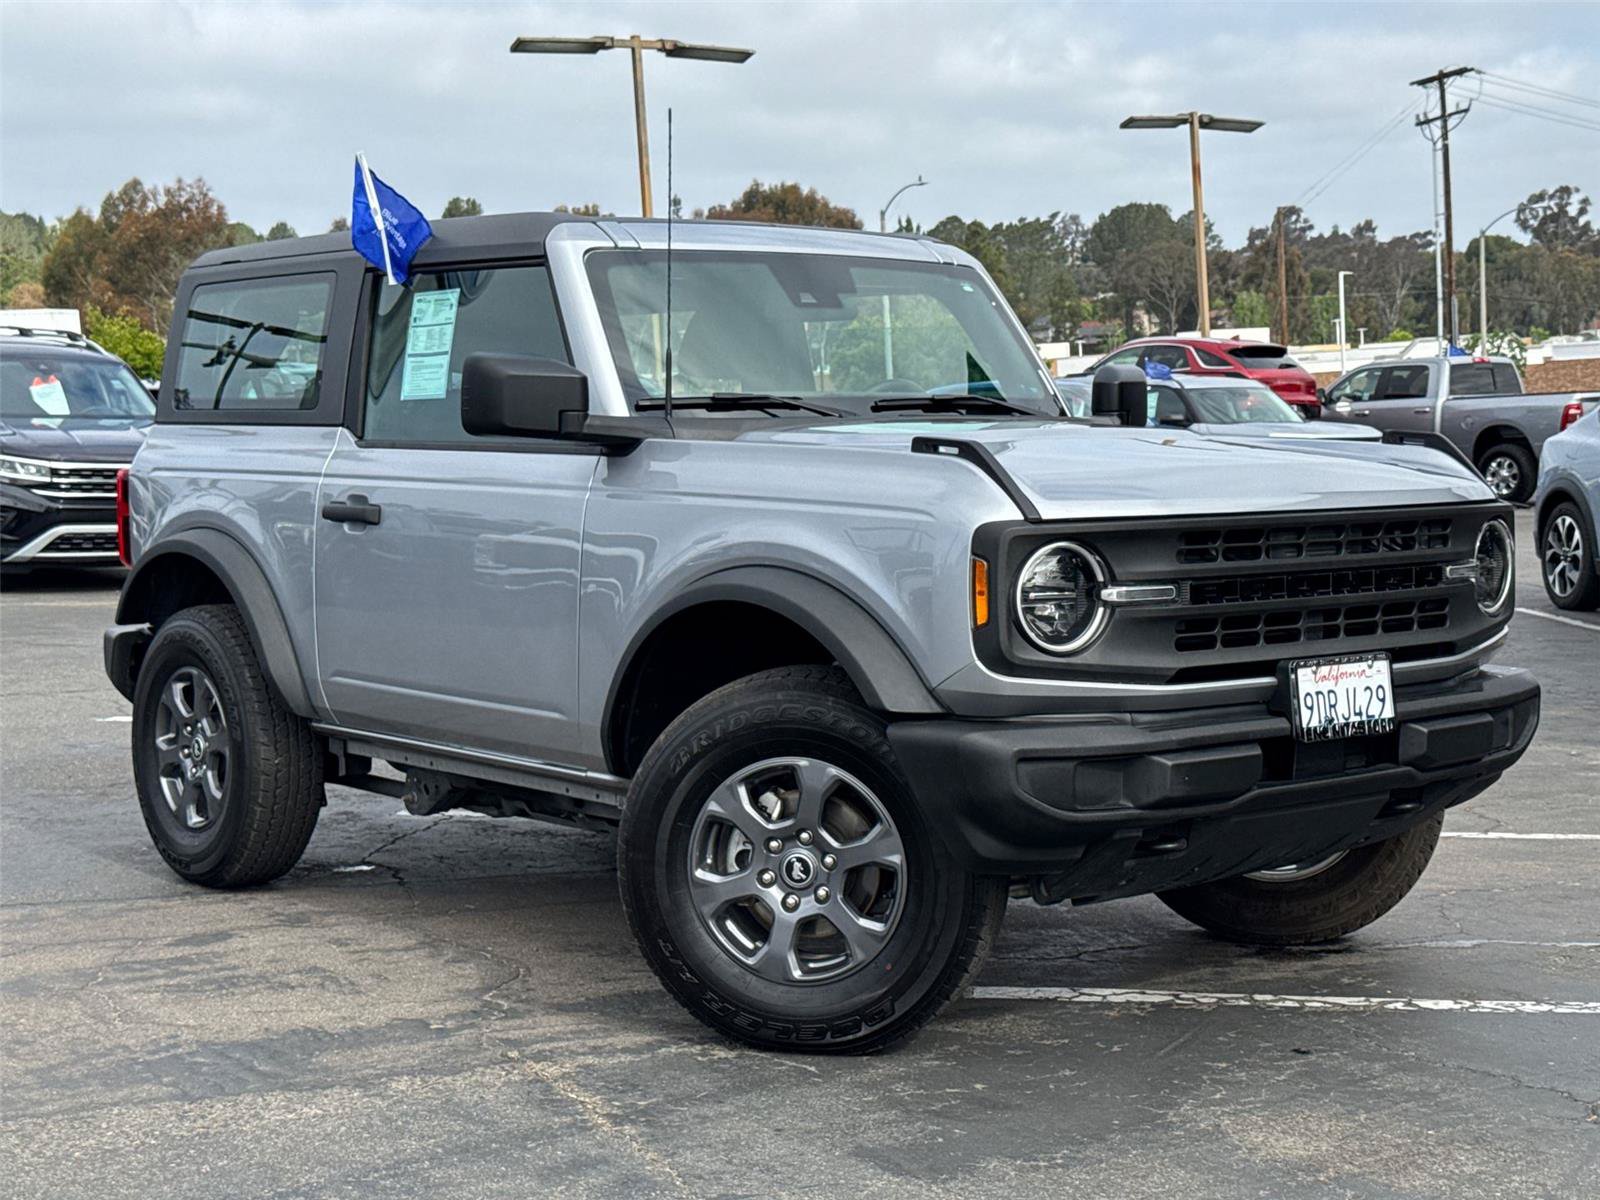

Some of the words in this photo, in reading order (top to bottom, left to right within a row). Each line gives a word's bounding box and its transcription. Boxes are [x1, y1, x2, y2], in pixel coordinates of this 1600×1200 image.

[382, 208, 399, 226] Blue
[1314, 664, 1373, 687] California
[1364, 716, 1394, 736] FORD
